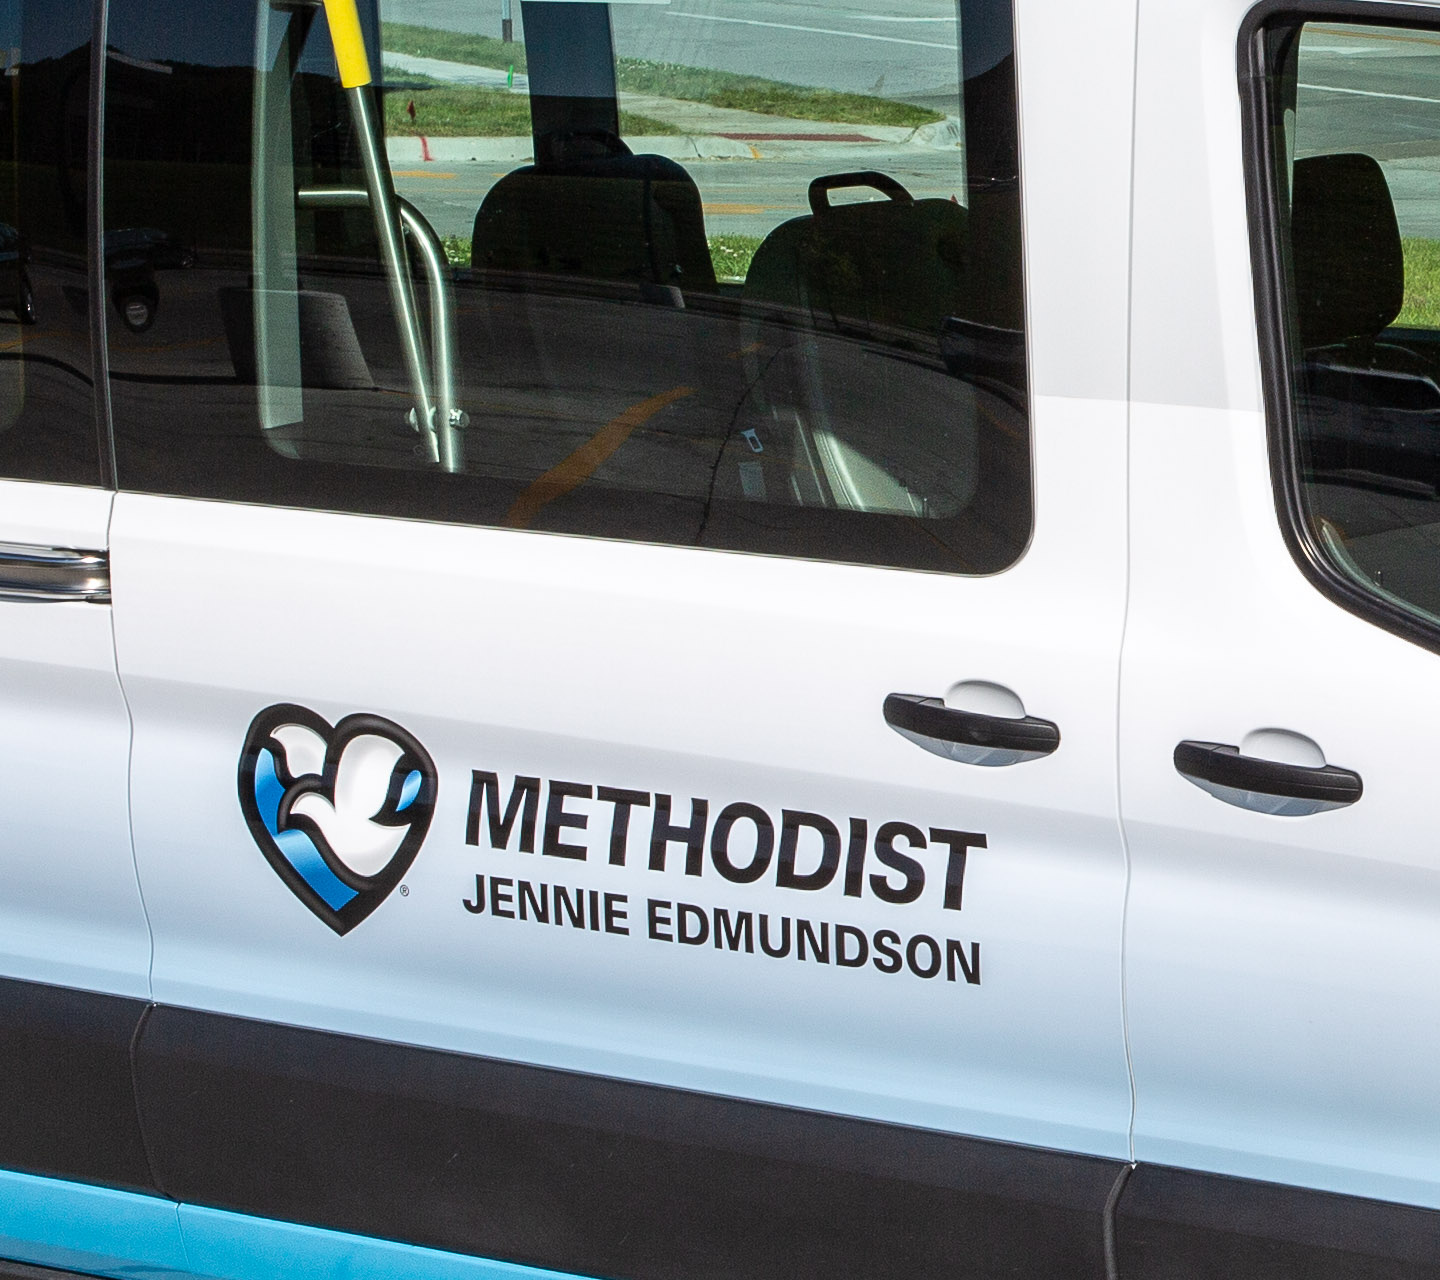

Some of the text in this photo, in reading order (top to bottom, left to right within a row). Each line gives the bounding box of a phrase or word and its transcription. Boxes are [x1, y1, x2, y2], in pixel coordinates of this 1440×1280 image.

[465, 769, 988, 911] METHODIST
[462, 874, 982, 985] JENNIE EDMUNDSON
